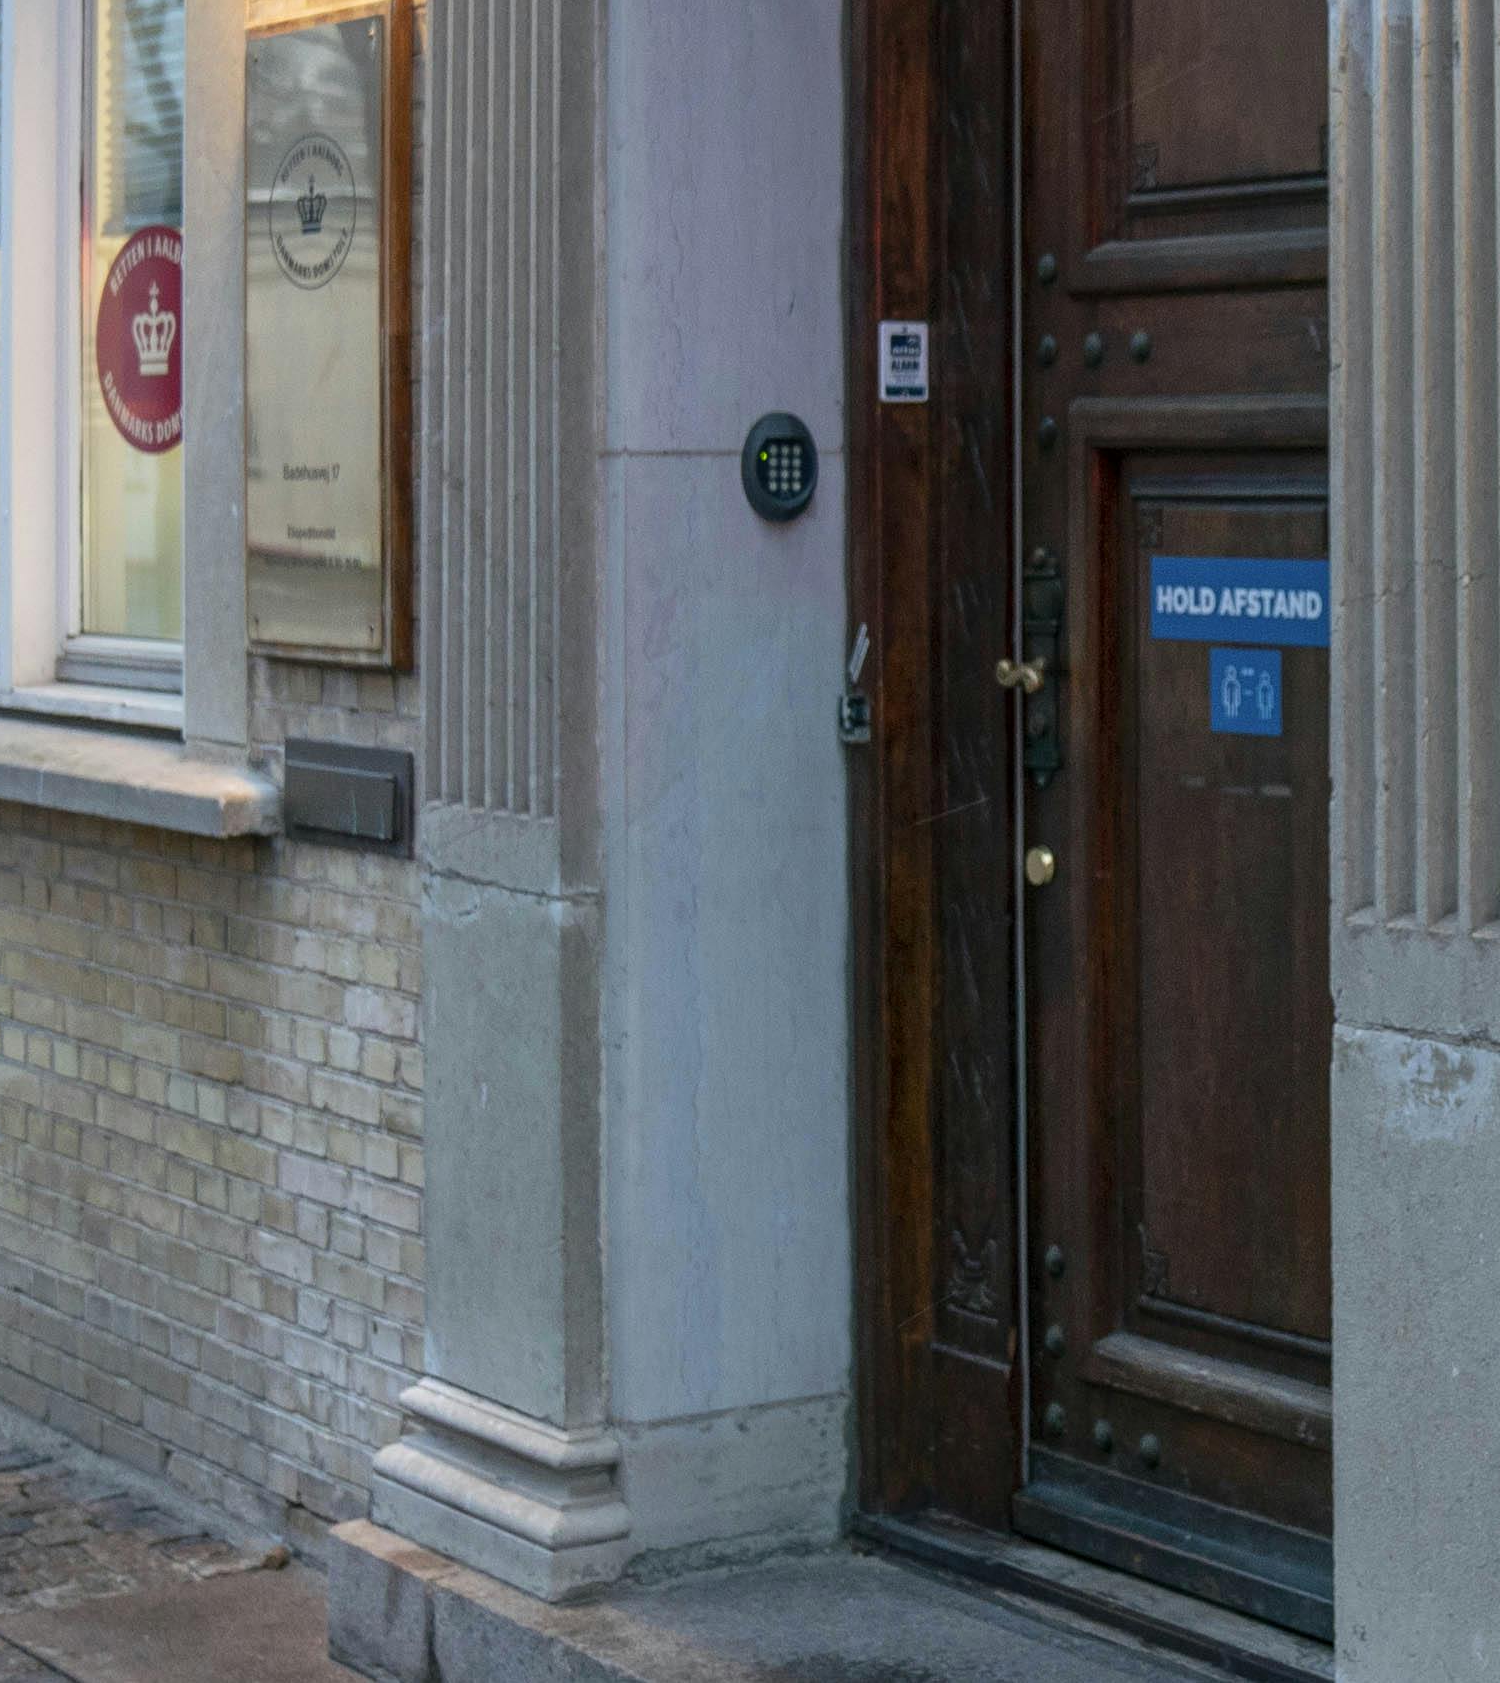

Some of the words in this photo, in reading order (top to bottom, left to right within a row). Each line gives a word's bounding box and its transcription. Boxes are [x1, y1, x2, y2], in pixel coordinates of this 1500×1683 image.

[109, 242, 144, 297] RETTEN
[147, 236, 152, 258] I
[154, 235, 182, 265] AALB
[103, 370, 153, 444] DANMARKS
[156, 408, 182, 444] DOM
[1156, 585, 1216, 615] HOLD
[1219, 586, 1323, 620] AFSTAND
